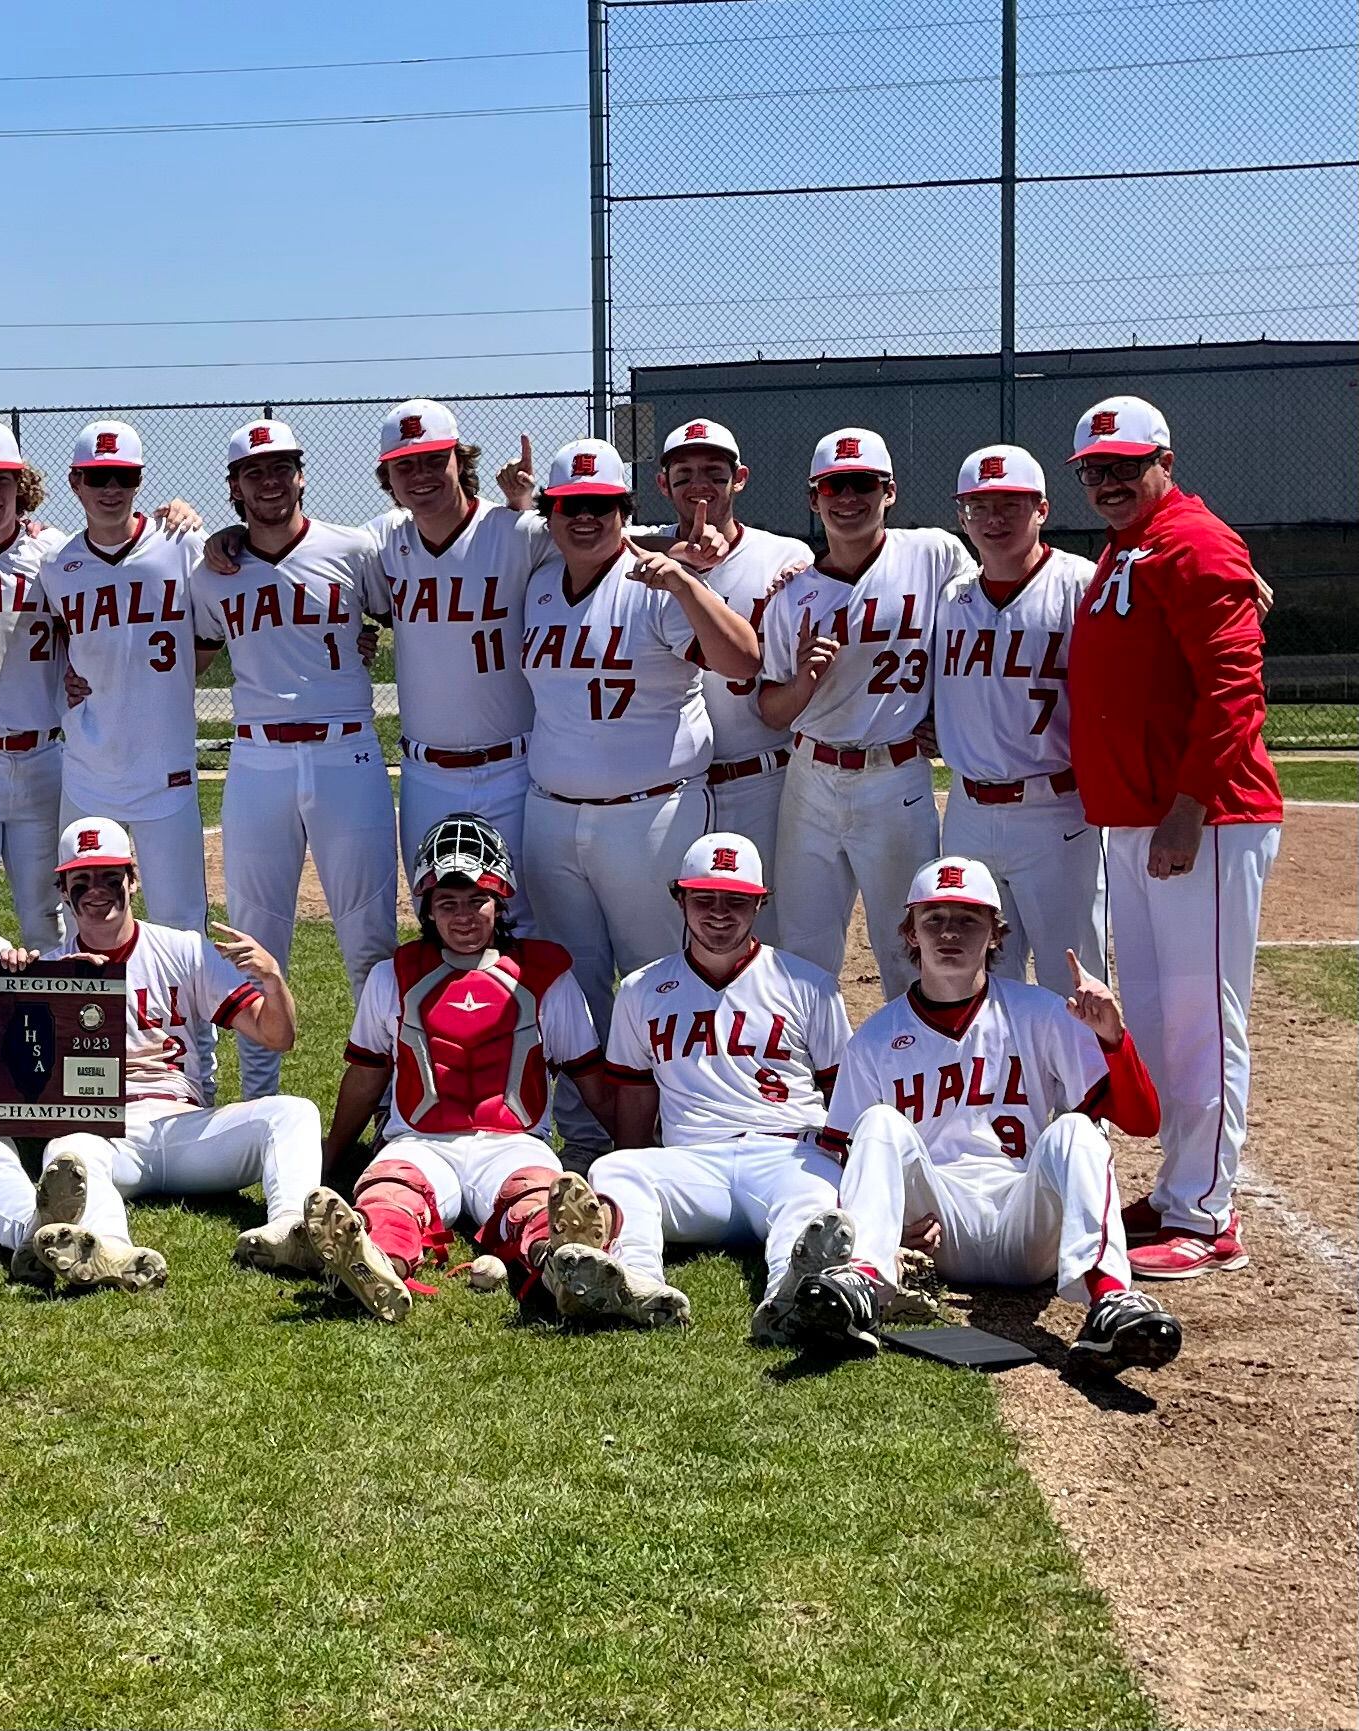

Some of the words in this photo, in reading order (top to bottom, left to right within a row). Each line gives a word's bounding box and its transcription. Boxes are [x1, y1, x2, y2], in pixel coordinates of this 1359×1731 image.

[60, 579, 186, 636] HALL
[219, 583, 350, 641] HALL
[384, 574, 509, 623] HALL
[148, 630, 177, 673] 3
[323, 632, 341, 671] 1
[471, 627, 506, 674] 11
[521, 624, 634, 671] HALL
[943, 629, 1069, 680] HALL
[867, 648, 929, 695] 23
[587, 677, 636, 721] 17
[1028, 687, 1059, 735] 7
[6, 978, 111, 991] REGIONAL
[134, 985, 188, 1031] LL
[72, 1037, 110, 1050] 2023
[647, 1009, 792, 1065] HALL
[754, 1066, 790, 1103] 8
[892, 1055, 1029, 1125] HALL
[991, 1114, 1027, 1161] 9
